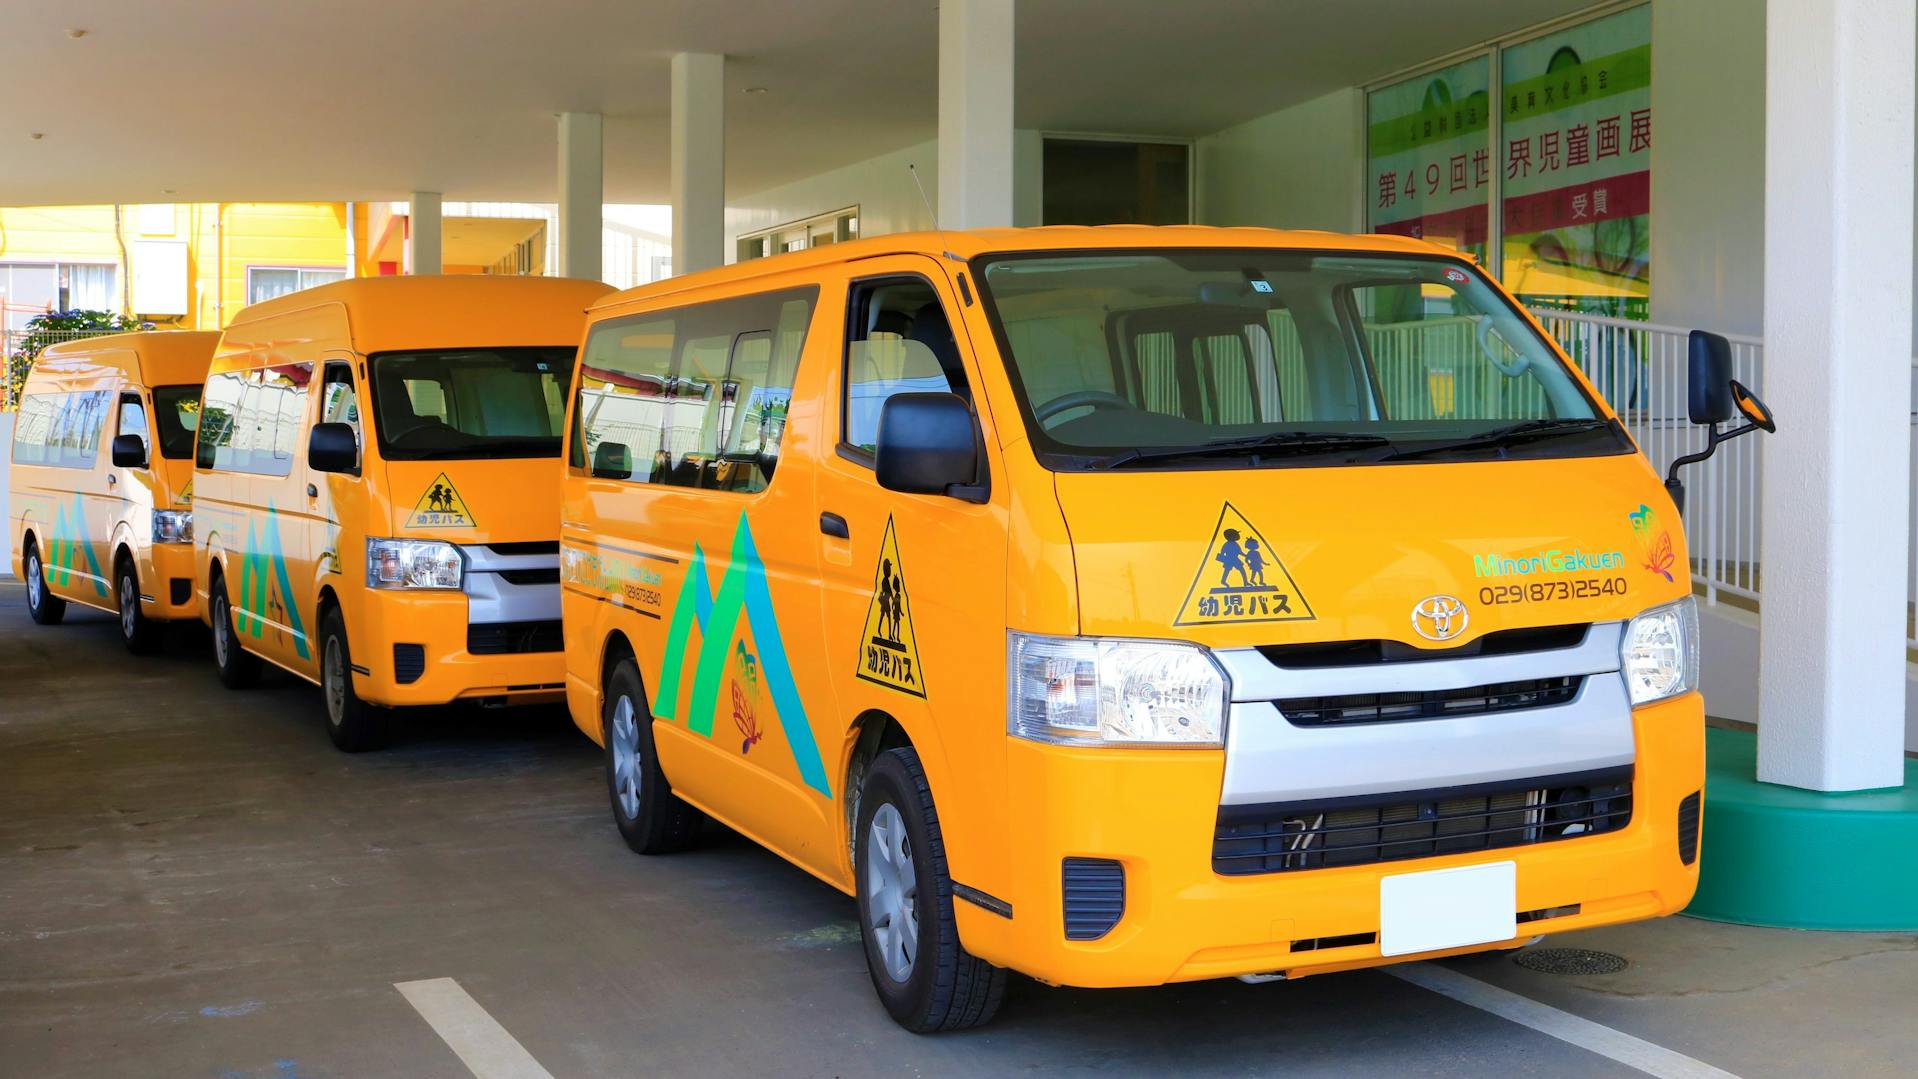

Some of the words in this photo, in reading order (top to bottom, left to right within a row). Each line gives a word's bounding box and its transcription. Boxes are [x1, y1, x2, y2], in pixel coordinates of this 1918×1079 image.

[417, 514, 465, 524] 幼児バス
[1473, 549, 1624, 577] MinoriGakuen
[1198, 594, 1292, 617] 幼児バス
[1479, 577, 1627, 606] 029(873)2540
[867, 645, 915, 686] 幼児バス
